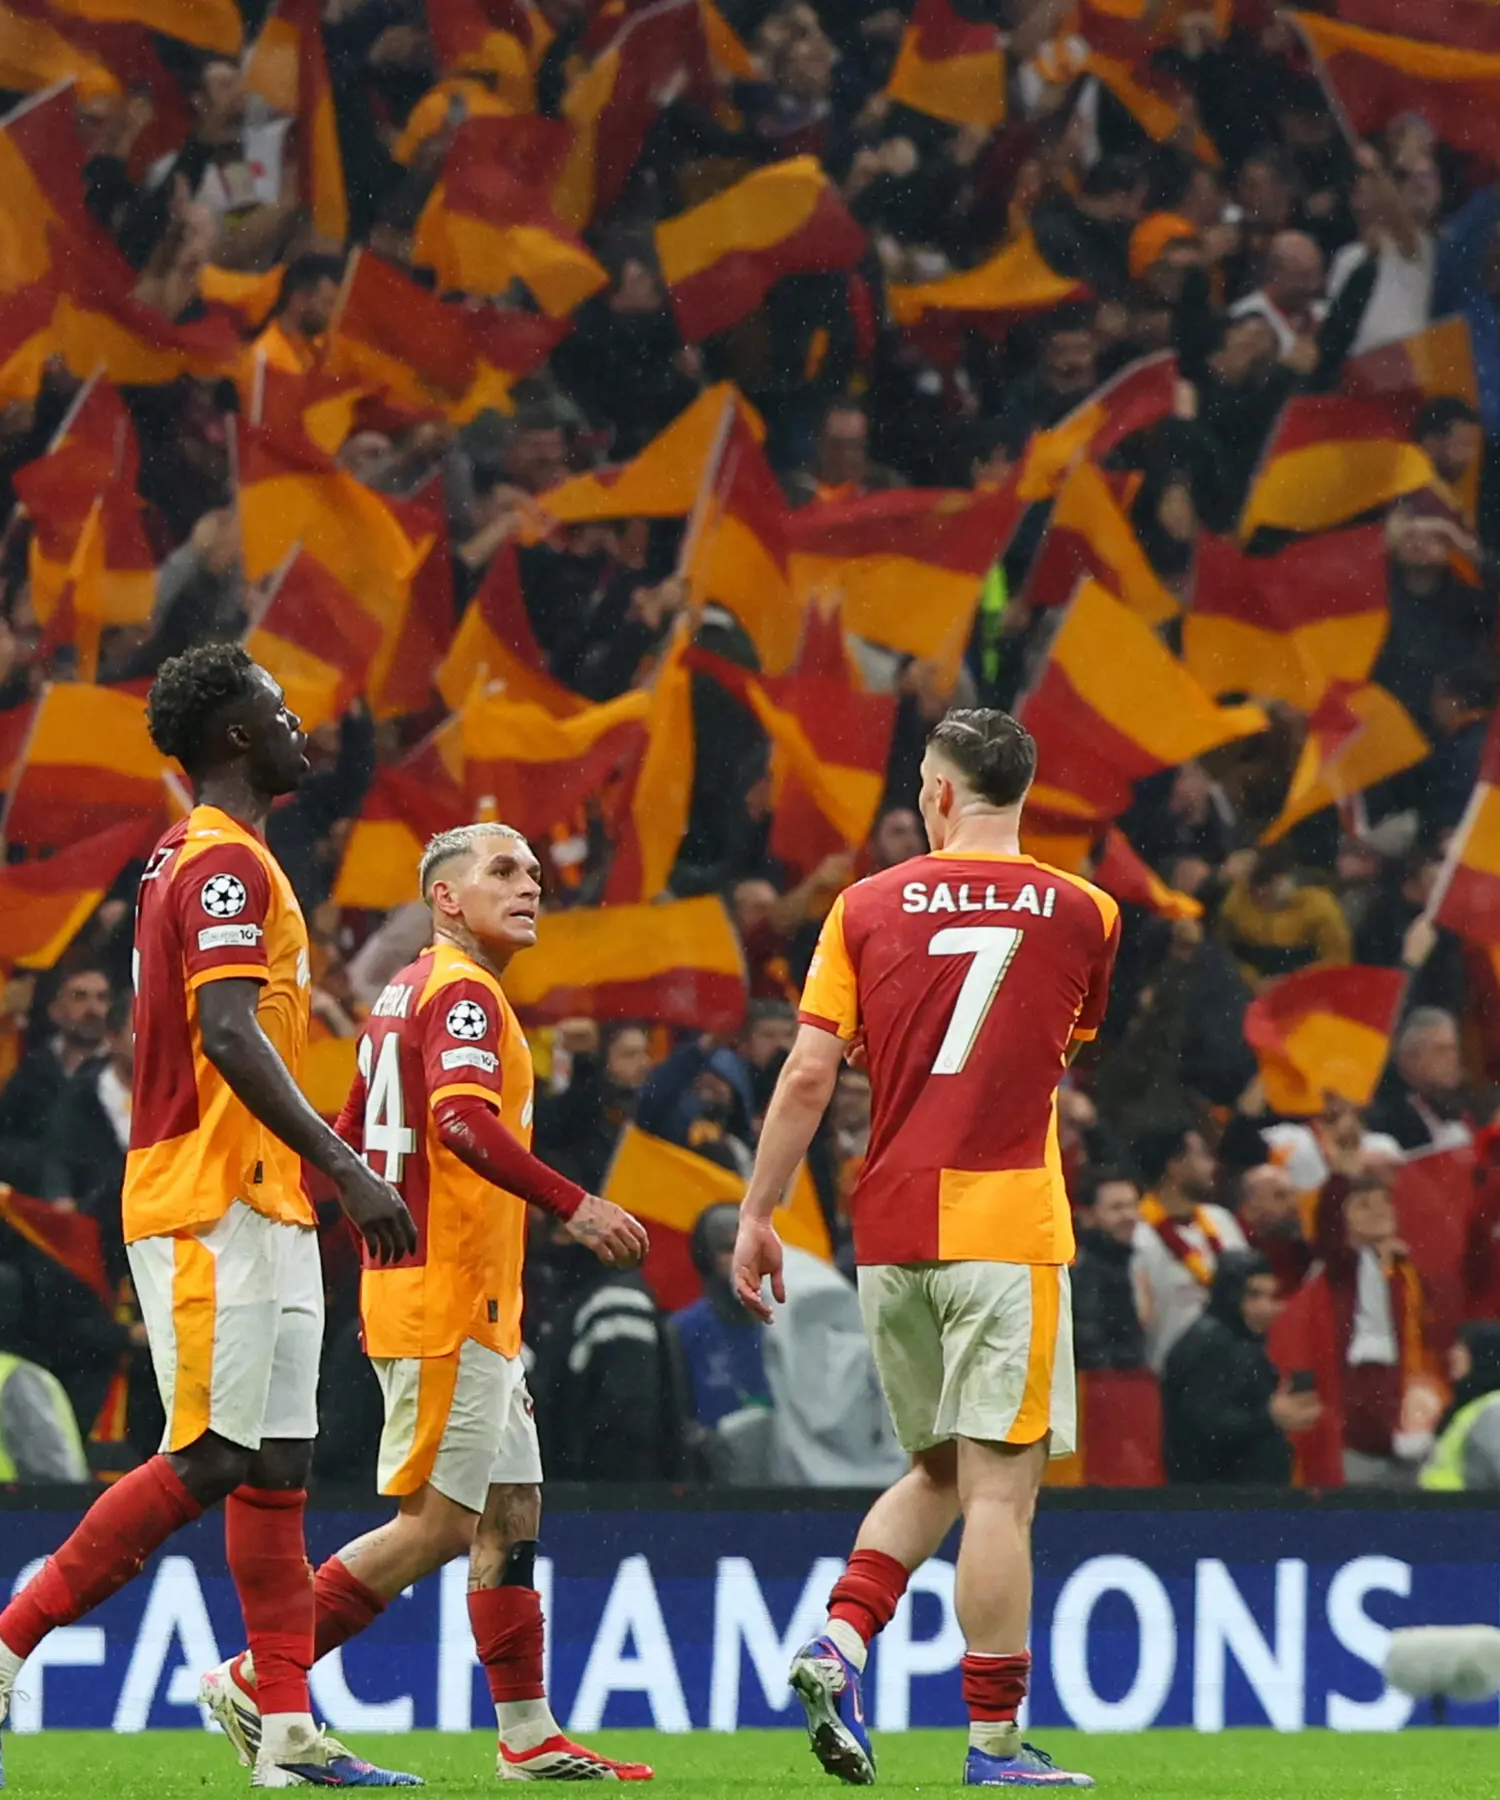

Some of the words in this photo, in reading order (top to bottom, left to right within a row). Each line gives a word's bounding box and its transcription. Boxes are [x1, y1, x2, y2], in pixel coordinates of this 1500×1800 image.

[901, 880, 1058, 919] SALLAI
[927, 926, 1024, 1075] 7
[306, 1553, 1415, 1734] CHAMPONS
